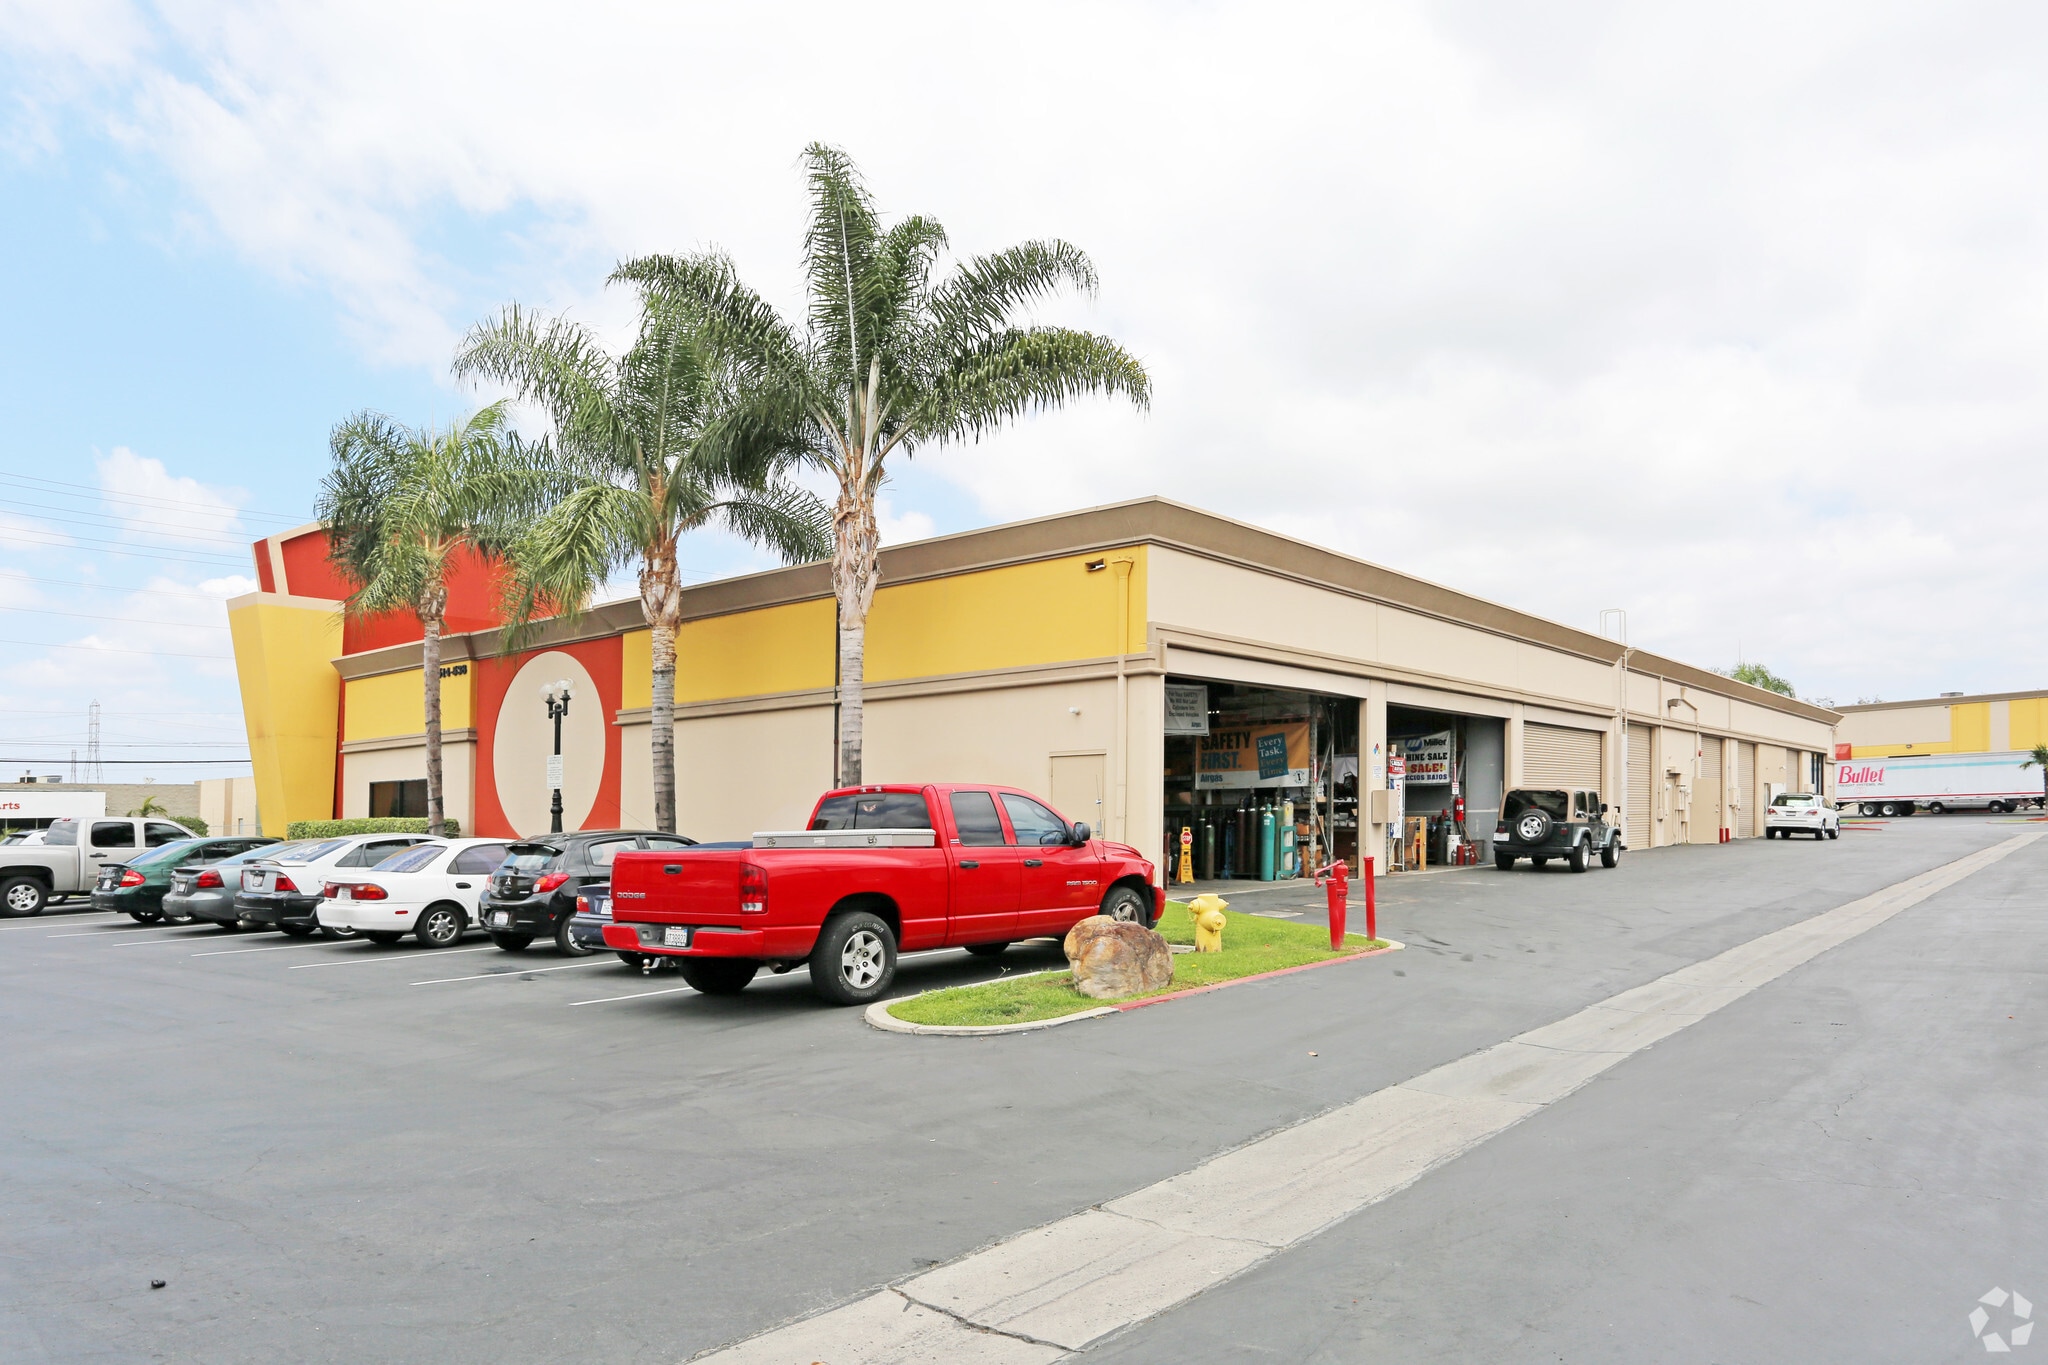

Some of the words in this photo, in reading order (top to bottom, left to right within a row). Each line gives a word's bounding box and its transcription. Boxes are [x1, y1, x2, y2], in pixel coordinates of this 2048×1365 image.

[1201, 732, 1251, 751] SAFETY
[1258, 737, 1283, 748] Every
[1423, 738, 1447, 746] Miller
[1259, 747, 1283, 758] Task.
[1405, 753, 1425, 761] HINE
[1260, 758, 1284, 768] Every
[1411, 763, 1443, 773] SALE!
[1200, 774, 1223, 783] Airgas
[1838, 765, 1885, 784] Bullet
[0, 802, 21, 810] rts
